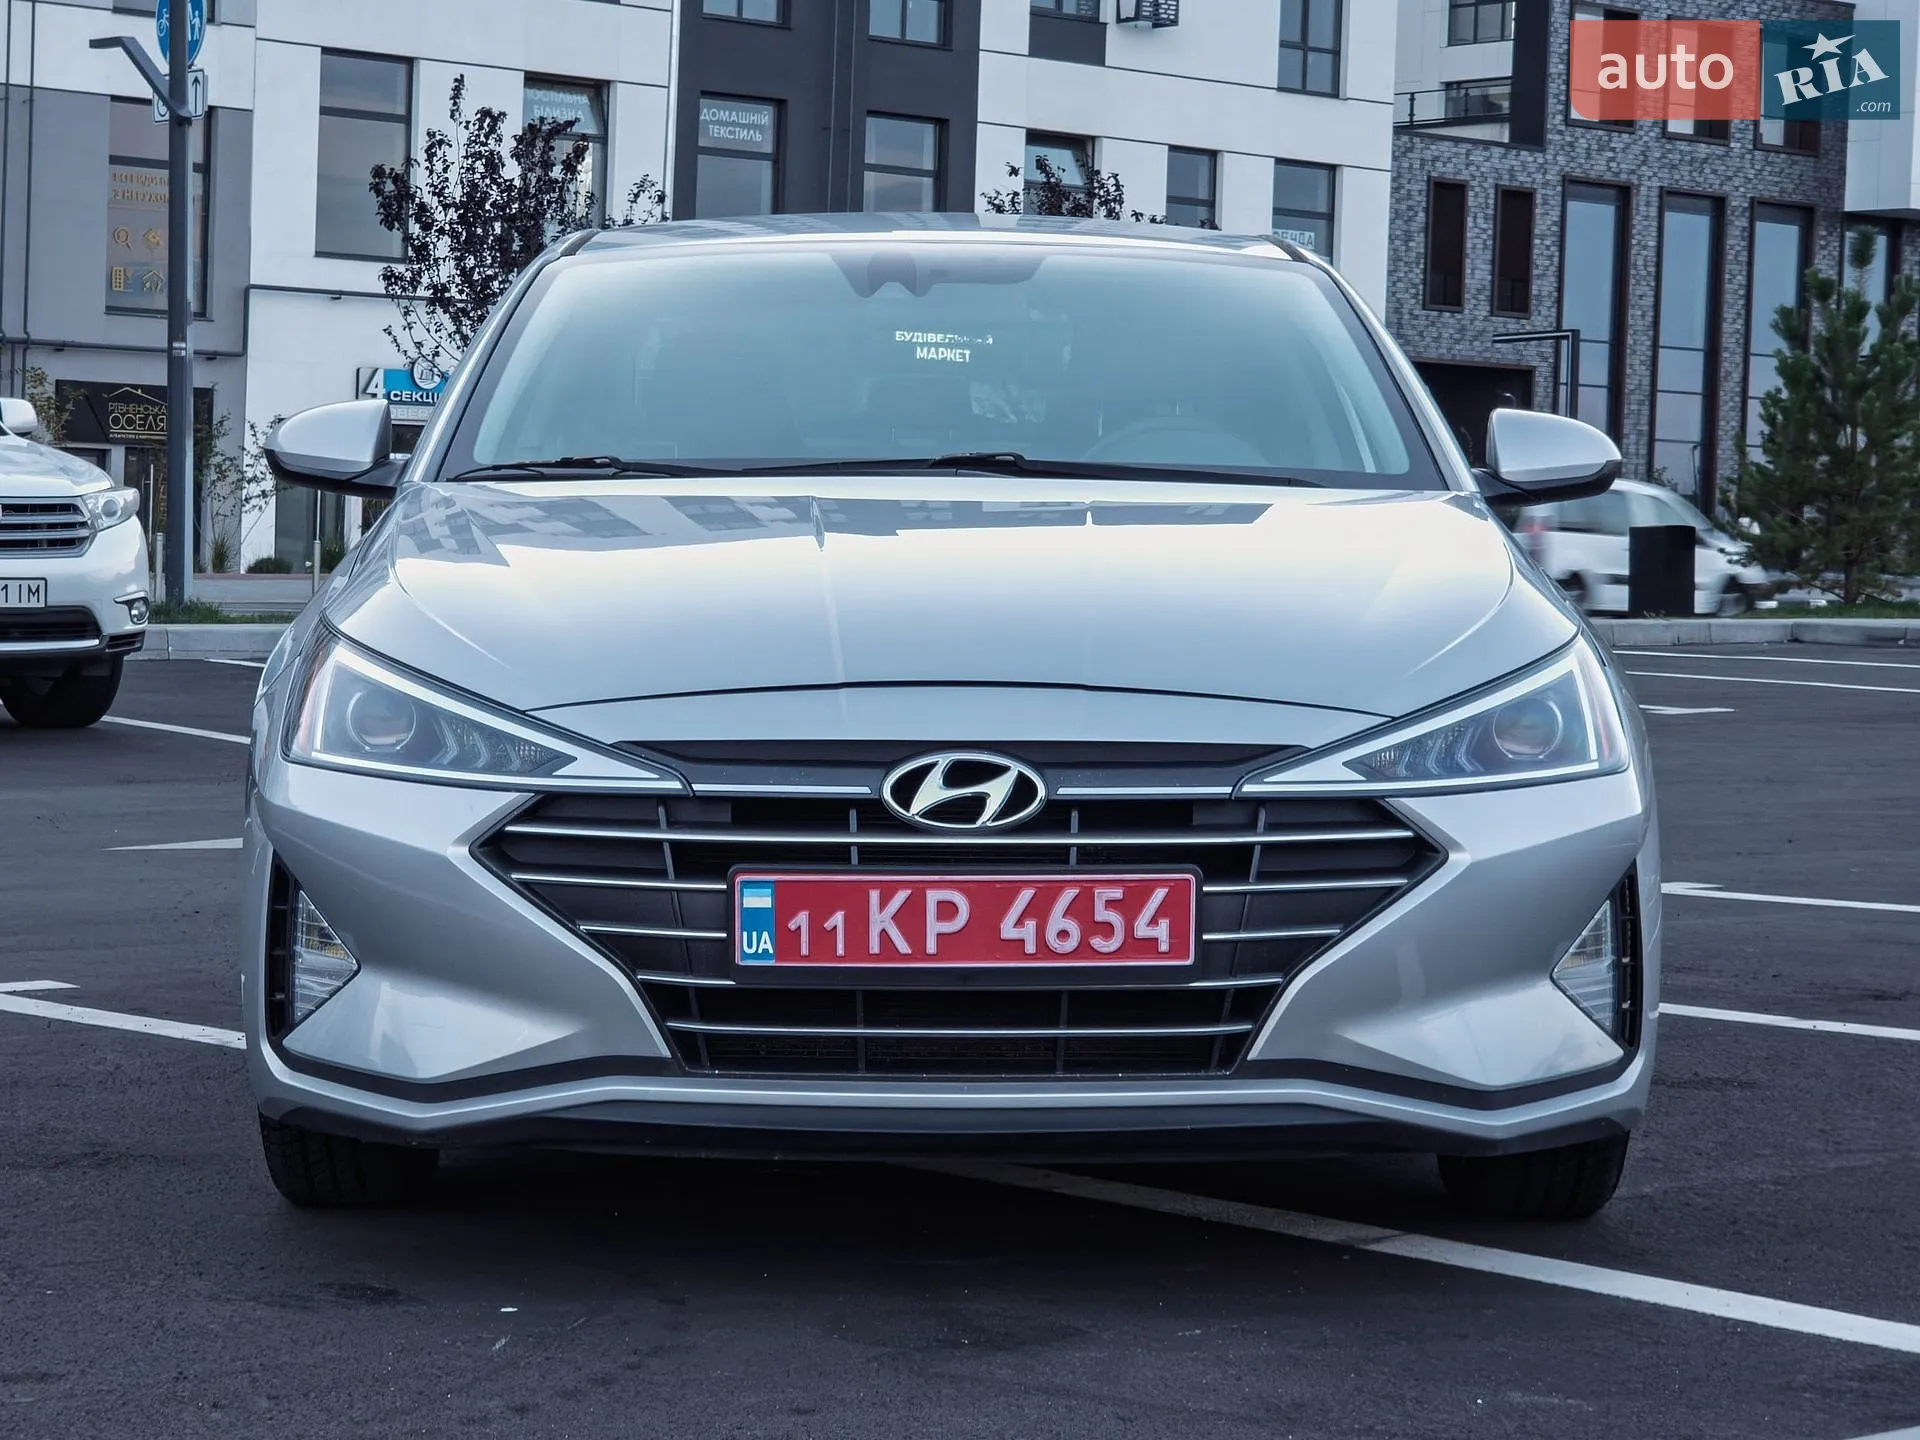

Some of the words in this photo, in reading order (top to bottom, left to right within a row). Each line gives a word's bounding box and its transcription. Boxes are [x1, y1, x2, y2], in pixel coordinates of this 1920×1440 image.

[700, 108, 769, 126] ДОМАШНІЙ
[708, 124, 762, 142] ТЕКСТИЛЬ
[916, 346, 971, 363] МАРКЕТ
[364, 368, 386, 399] 4
[390, 390, 438, 403] СЕКЦІ
[109, 413, 167, 431] ОСЕЛЯ
[787, 910, 847, 957] 11
[867, 887, 971, 956] KP
[999, 887, 1170, 955] 4654
[743, 931, 774, 954] UA
